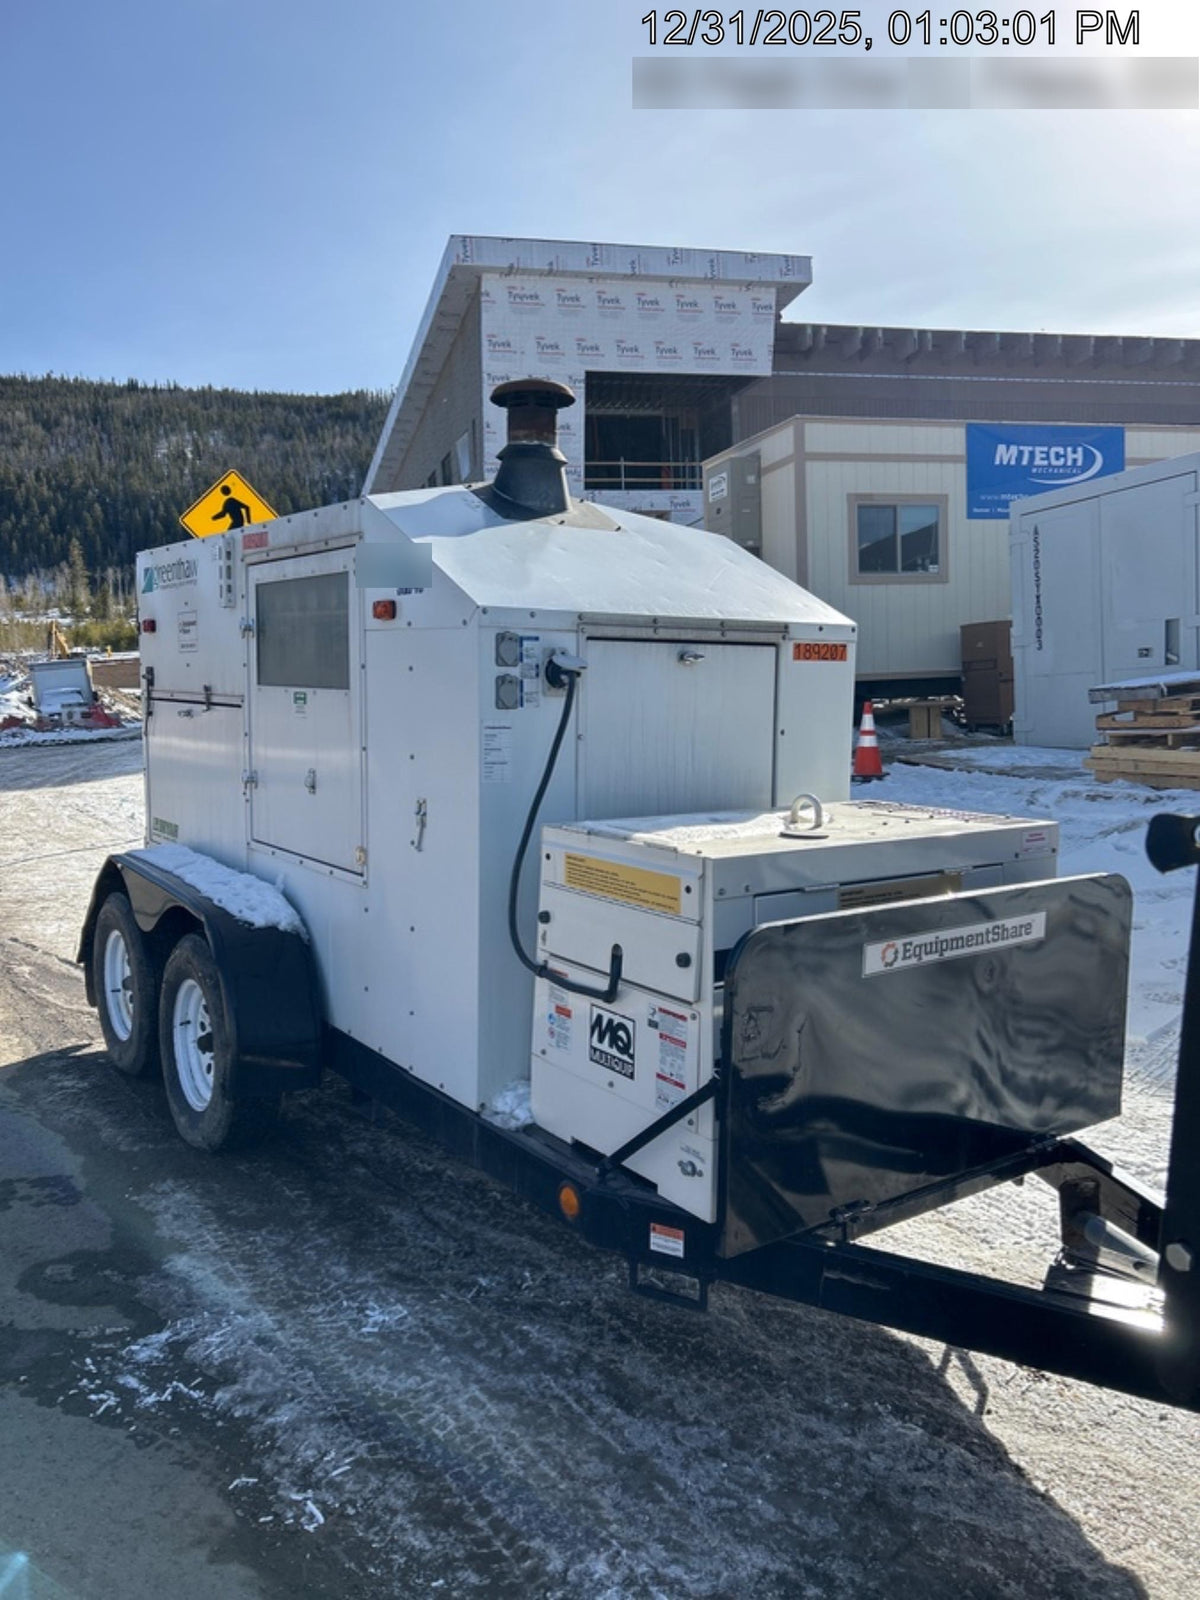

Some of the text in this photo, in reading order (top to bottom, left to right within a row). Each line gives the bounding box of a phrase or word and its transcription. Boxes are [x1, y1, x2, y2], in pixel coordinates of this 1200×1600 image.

[556, 293, 580, 303] Tyvek
[597, 295, 621, 305] Tyvek
[637, 297, 660, 308] Tyvek
[676, 299, 699, 309] Tyvek
[714, 300, 736, 310] Tyvek
[752, 302, 773, 311] Tyvek
[487, 339, 512, 349] Tyvek
[536, 341, 560, 351] Tyvek
[576, 342, 600, 352] Tyvek
[616, 344, 639, 354] Tyvek
[656, 346, 678, 356] Tyvek
[694, 347, 715, 357] Tyvek
[731, 348, 753, 358] Tyvek
[994, 444, 1084, 467] MTECH
[793, 643, 847, 660] 189207
[901, 921, 1033, 962] EquipmentShare
[591, 1012, 635, 1060] MQ
